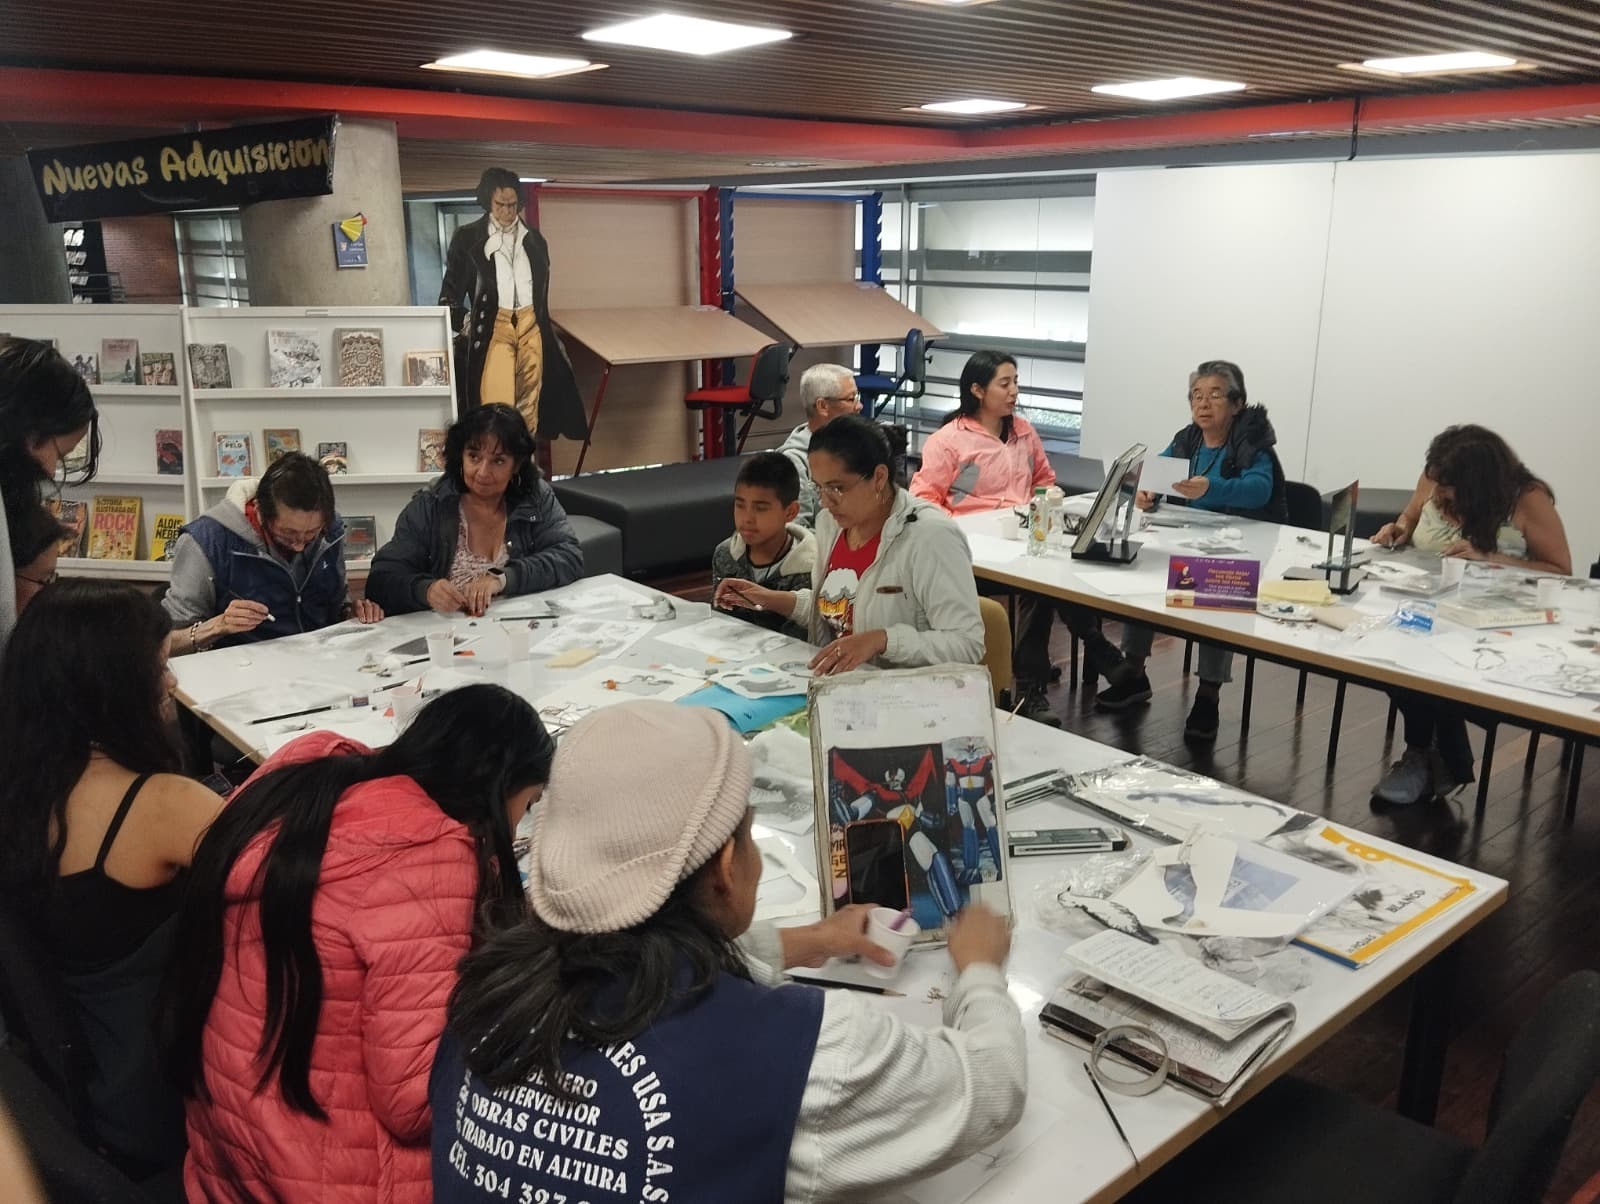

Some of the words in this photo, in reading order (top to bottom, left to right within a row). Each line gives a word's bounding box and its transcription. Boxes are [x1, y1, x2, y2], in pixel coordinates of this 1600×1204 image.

[42, 155, 149, 196] Nuevas
[94, 513, 135, 530] ROCK
[155, 529, 179, 540] NEBE
[1386, 889, 1426, 913] BLANCO
[632, 1071, 671, 1132] USA
[472, 1092, 530, 1133] OBRAS
[533, 1118, 629, 1160] CIVILES
[462, 1116, 514, 1161] TRABAJO
[517, 1144, 544, 1171] EN
[545, 1154, 627, 1194] ALTURA
[474, 1163, 511, 1199] 304
